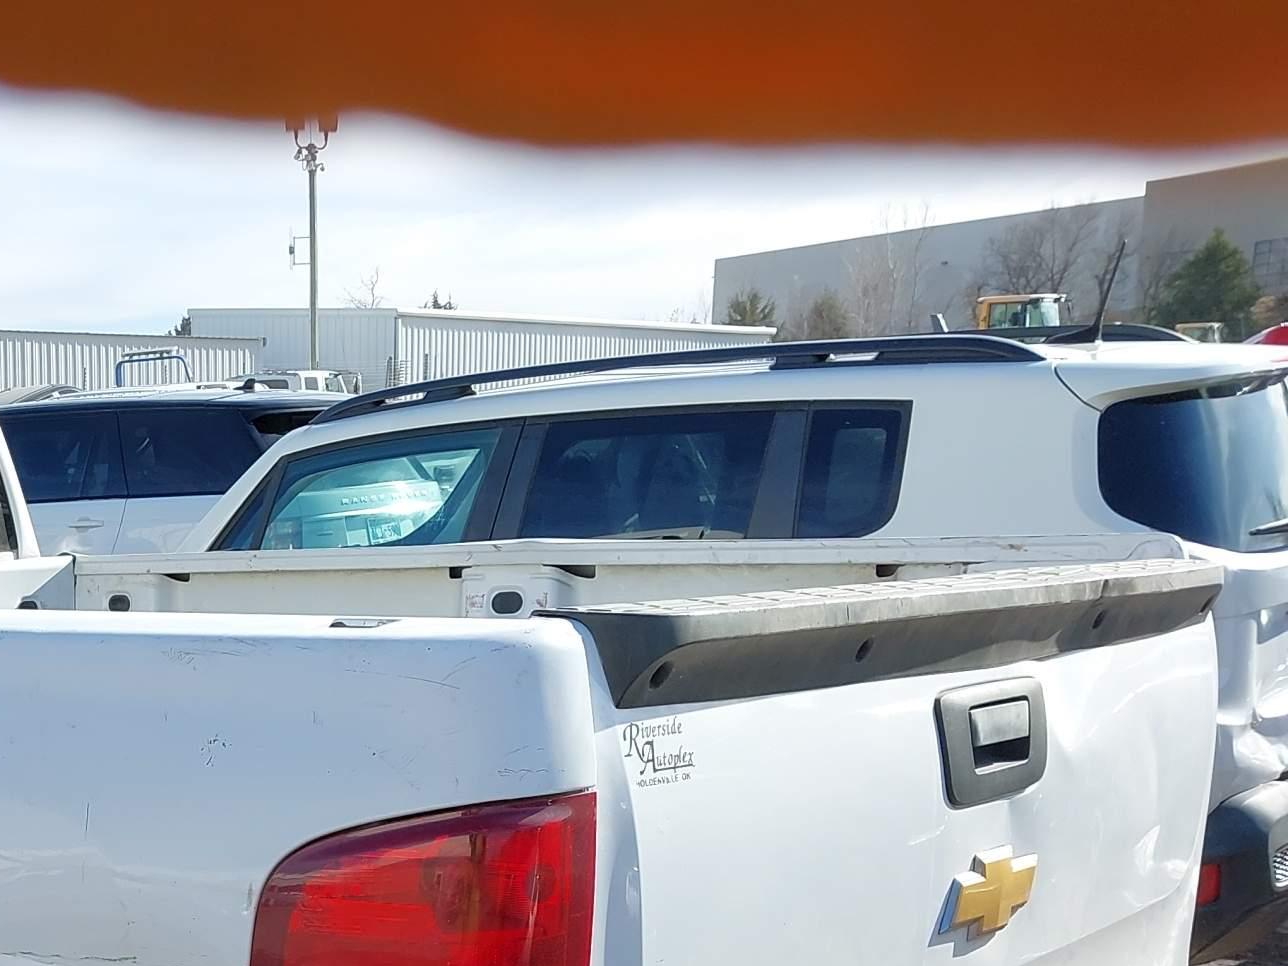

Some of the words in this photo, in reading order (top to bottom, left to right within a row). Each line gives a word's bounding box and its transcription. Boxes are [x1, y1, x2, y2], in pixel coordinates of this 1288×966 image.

[623, 716, 682, 757] Riverside
[640, 740, 695, 776] Autoplex
[682, 772, 692, 781] OK
